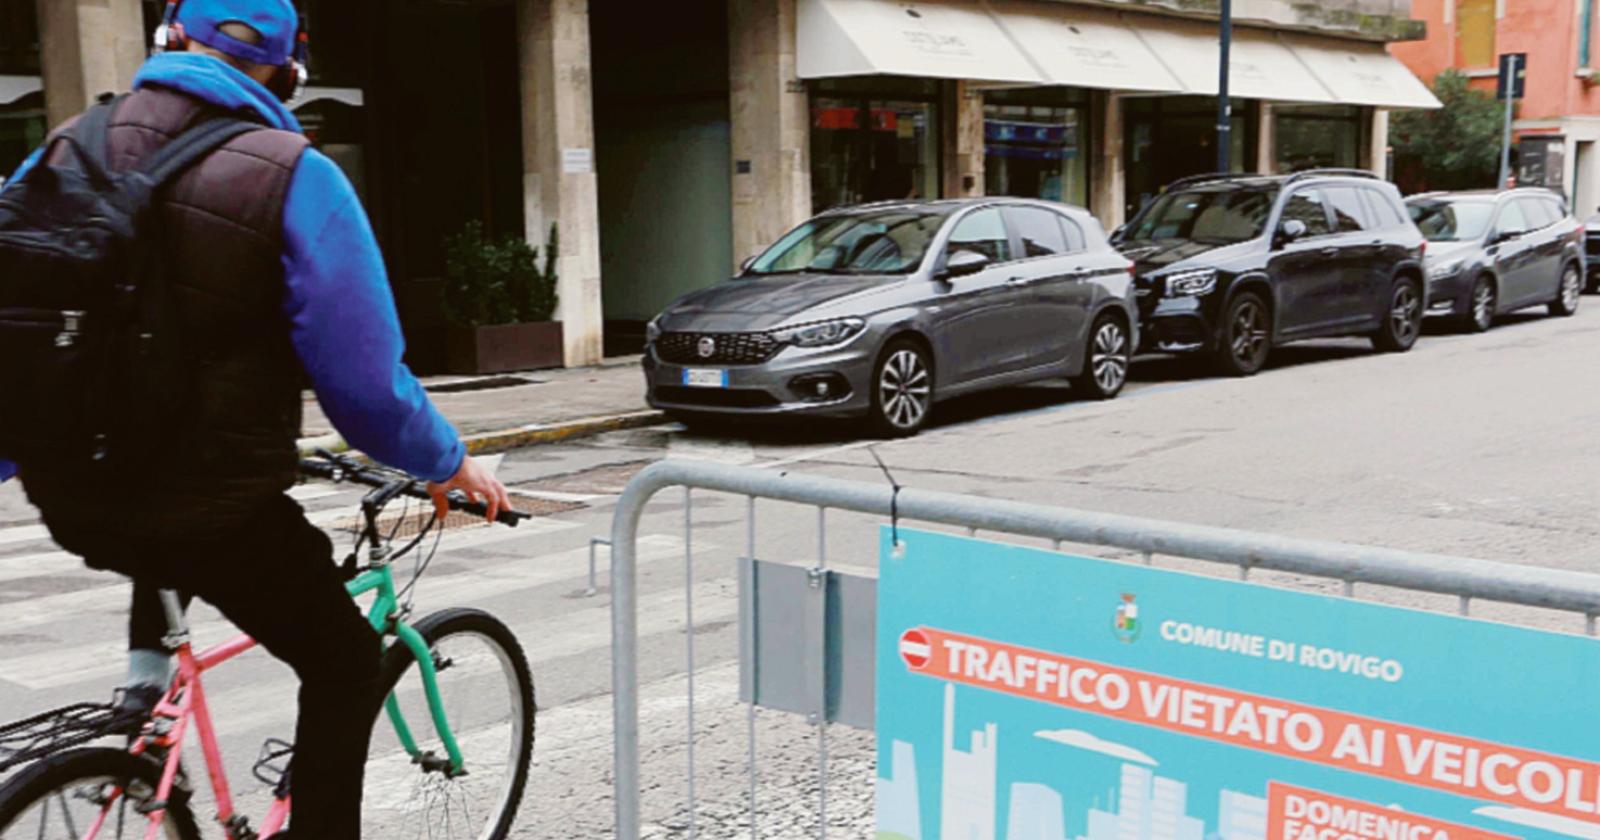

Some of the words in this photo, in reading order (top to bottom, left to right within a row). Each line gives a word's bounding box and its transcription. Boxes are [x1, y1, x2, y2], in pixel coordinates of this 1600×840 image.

[1160, 620, 1264, 656] COMUNE
[1268, 639, 1295, 662] DI
[1300, 645, 1402, 681] ROVIGO
[943, 640, 1130, 710] TRAFFICO
[1138, 681, 1324, 752] VIETATO
[1332, 723, 1385, 767] AI
[1395, 733, 1600, 814] VEICOL
